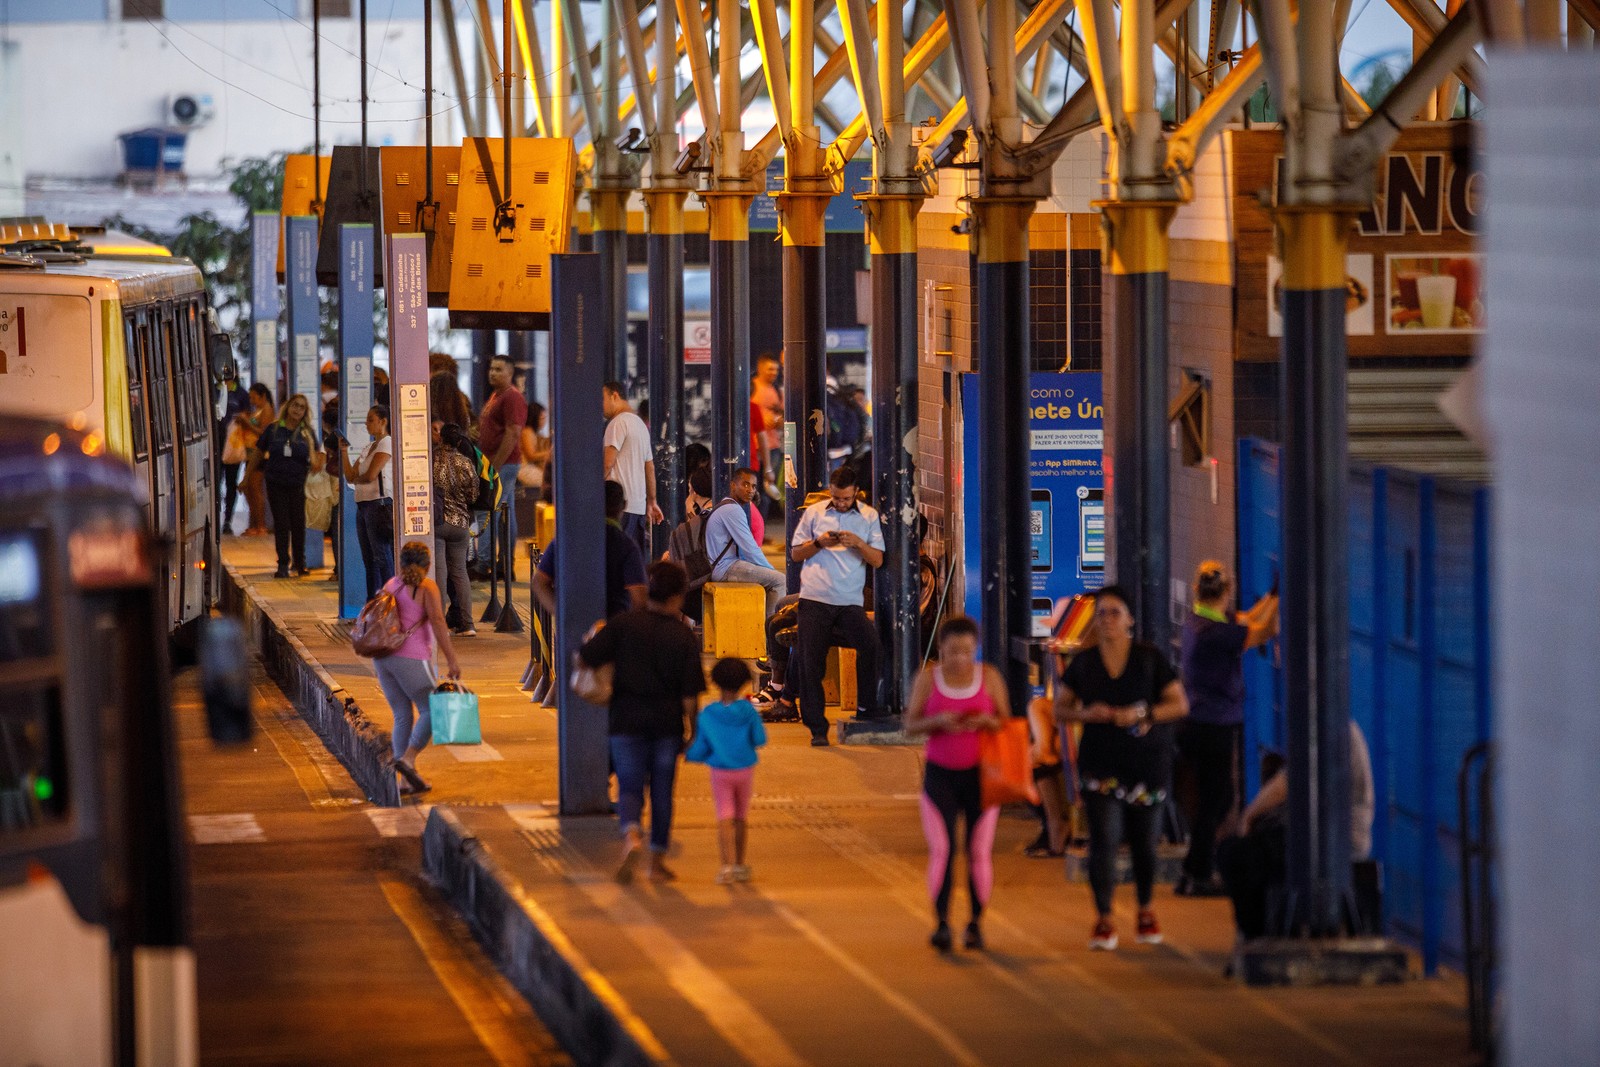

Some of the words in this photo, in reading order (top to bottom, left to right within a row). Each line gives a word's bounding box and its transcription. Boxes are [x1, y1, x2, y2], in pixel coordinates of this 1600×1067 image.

[1030, 389, 1061, 398] com
[1065, 388, 1074, 398] o
[1046, 460, 1061, 468] App
